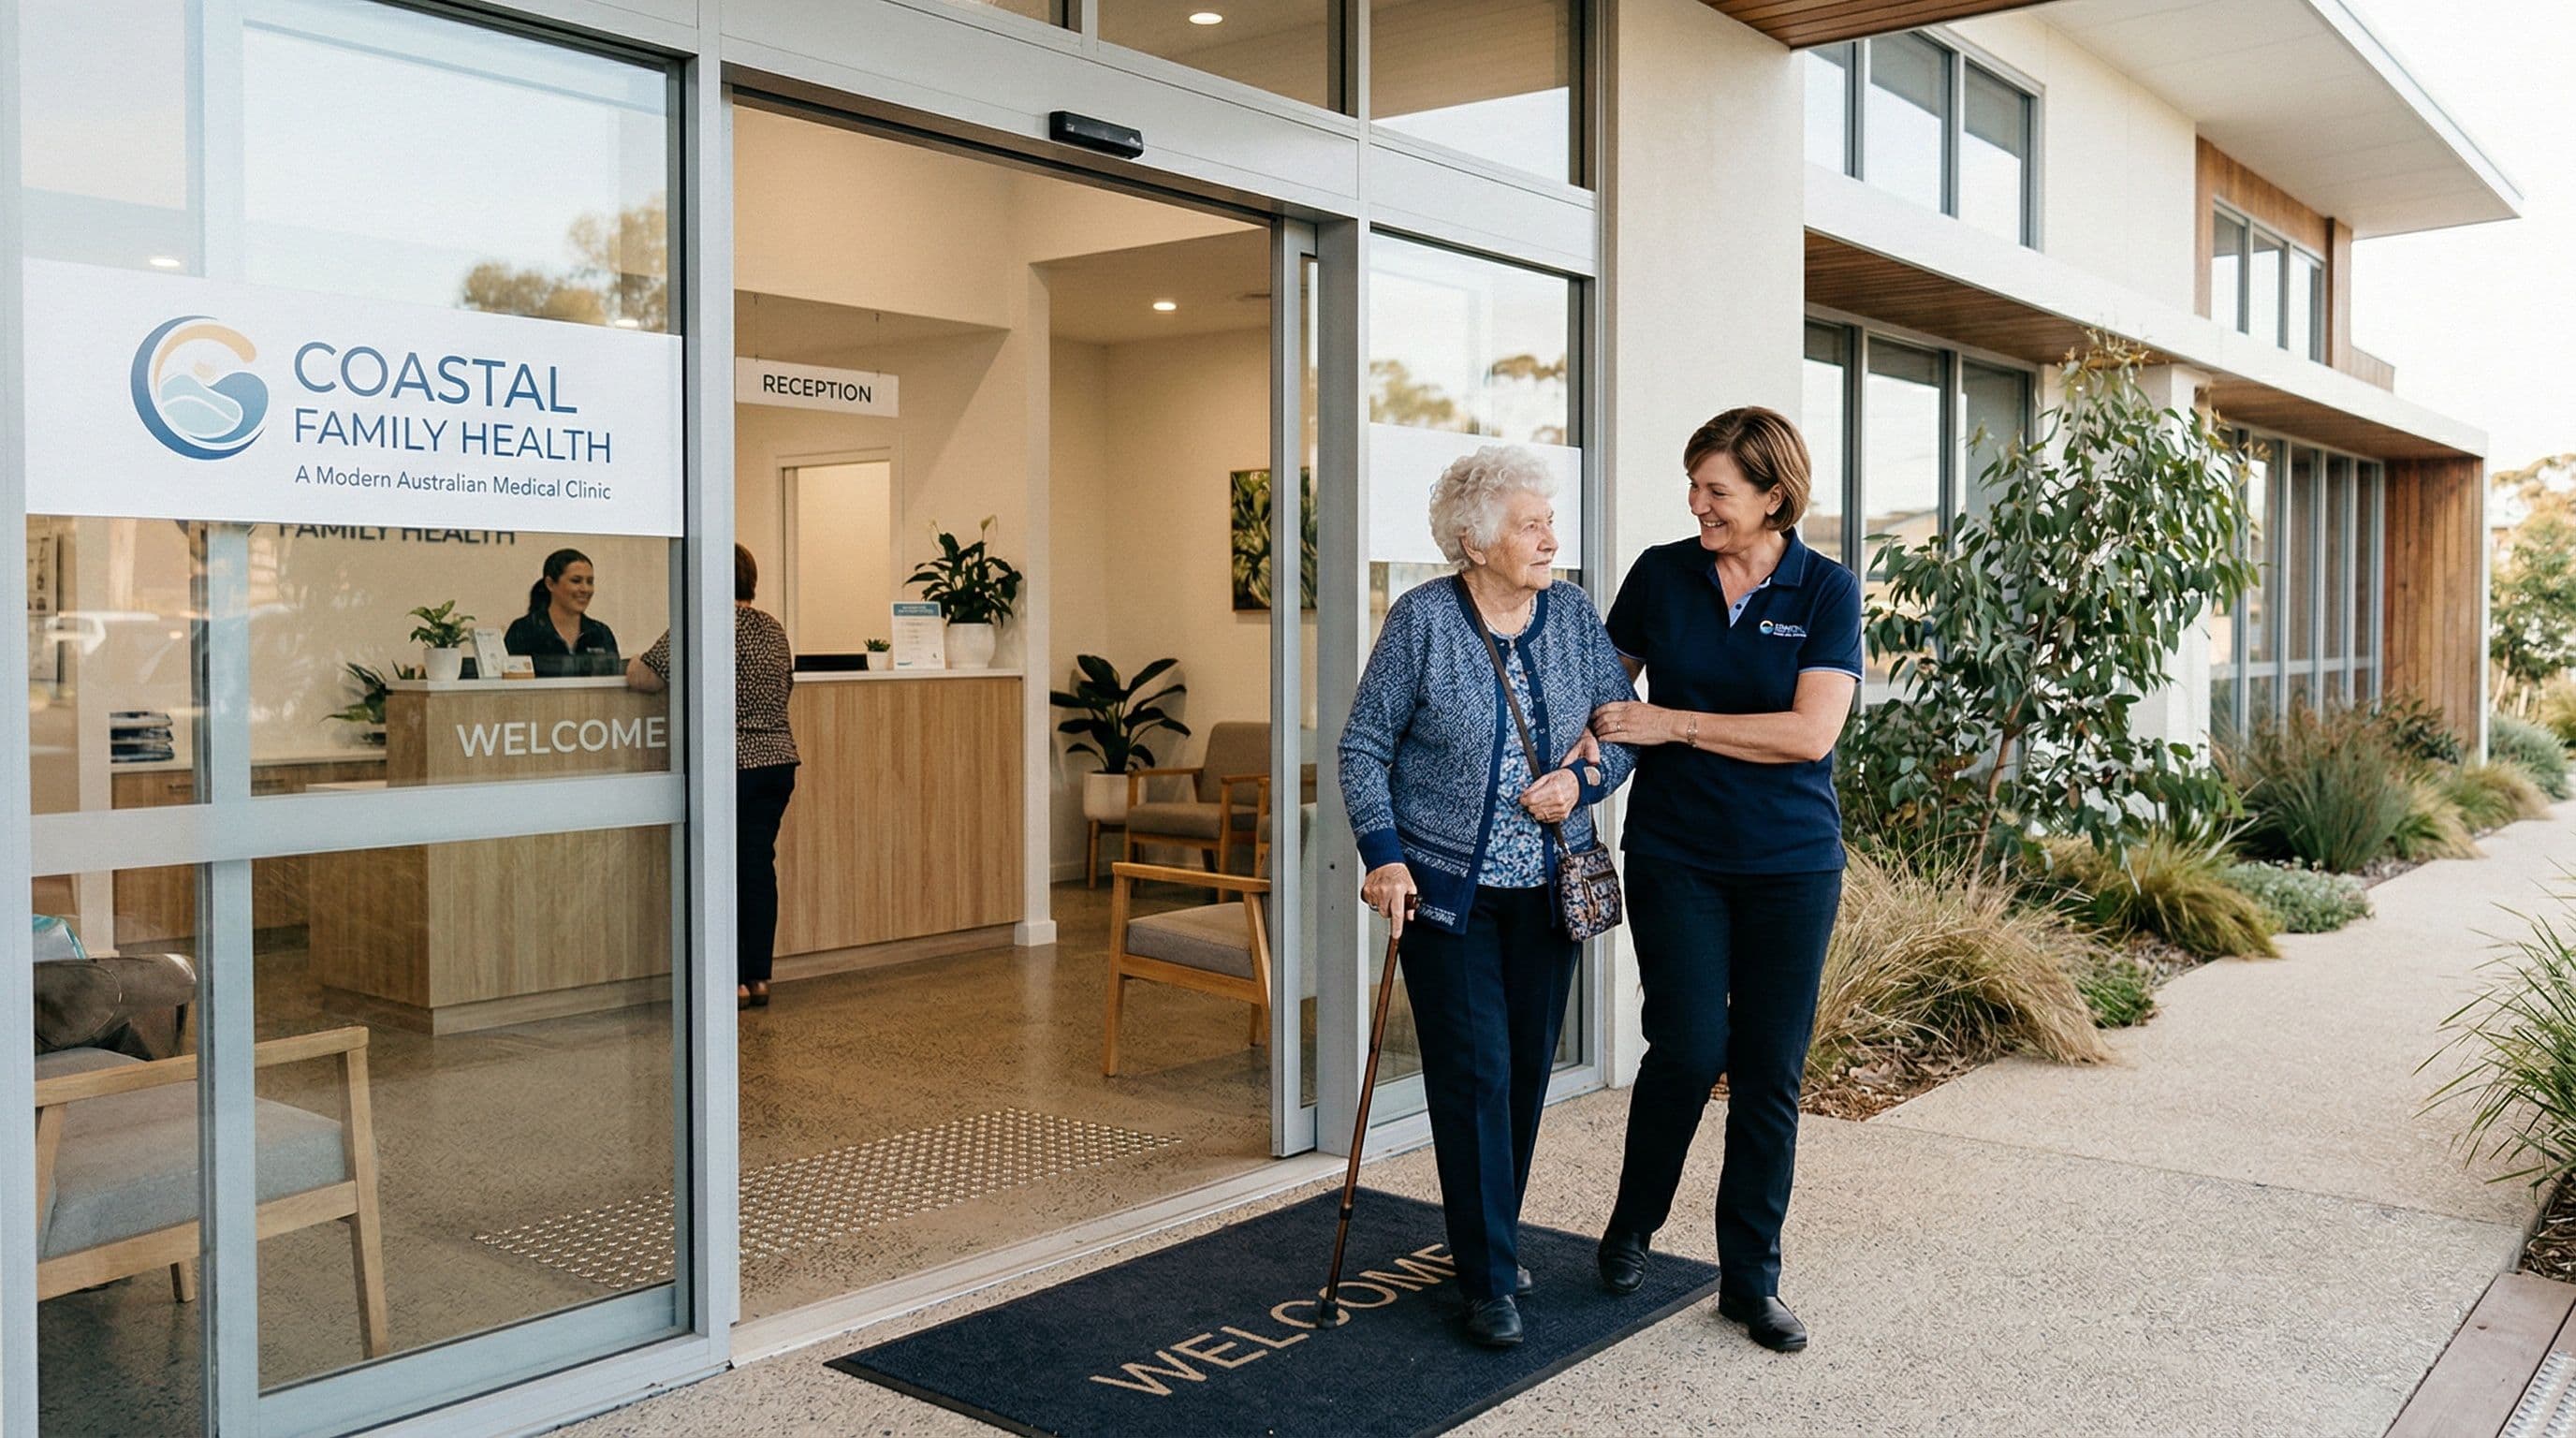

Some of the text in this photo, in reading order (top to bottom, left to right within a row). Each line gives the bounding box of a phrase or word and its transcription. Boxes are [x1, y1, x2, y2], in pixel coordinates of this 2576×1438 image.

[294, 342, 578, 414] COASTAL
[763, 374, 871, 403] RECEPTION
[296, 407, 610, 463] FAMILY HEALTH
[295, 465, 611, 500] A Modern Australian Medical Clinic
[456, 716, 666, 757] WELCOME
